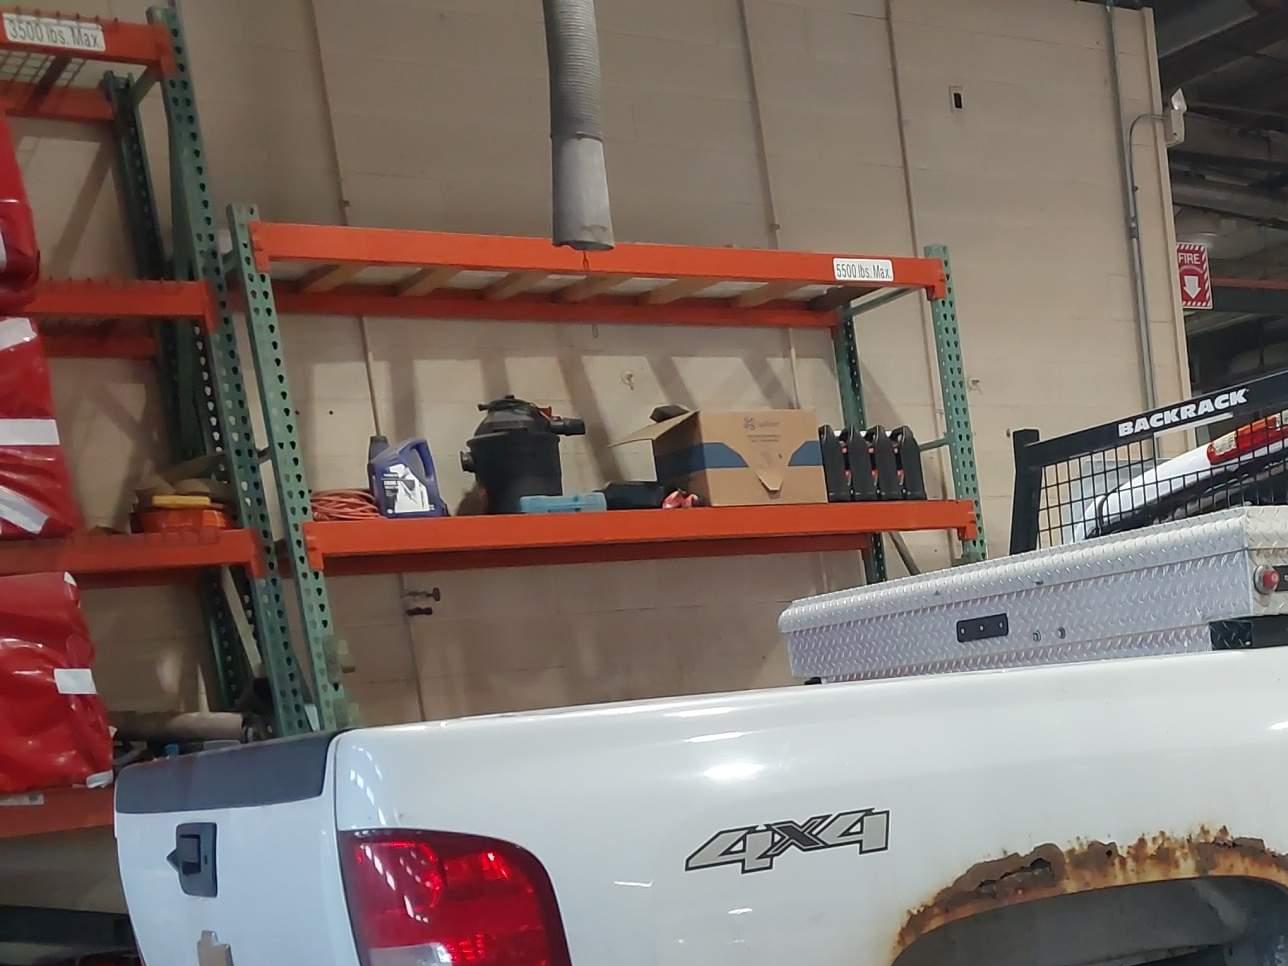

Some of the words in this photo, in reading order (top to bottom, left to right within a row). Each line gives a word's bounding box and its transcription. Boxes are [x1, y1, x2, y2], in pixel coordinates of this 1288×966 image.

[1178, 252, 1201, 265] FIRE
[836, 263, 857, 279] 5500
[1117, 388, 1248, 437] BACKRACK
